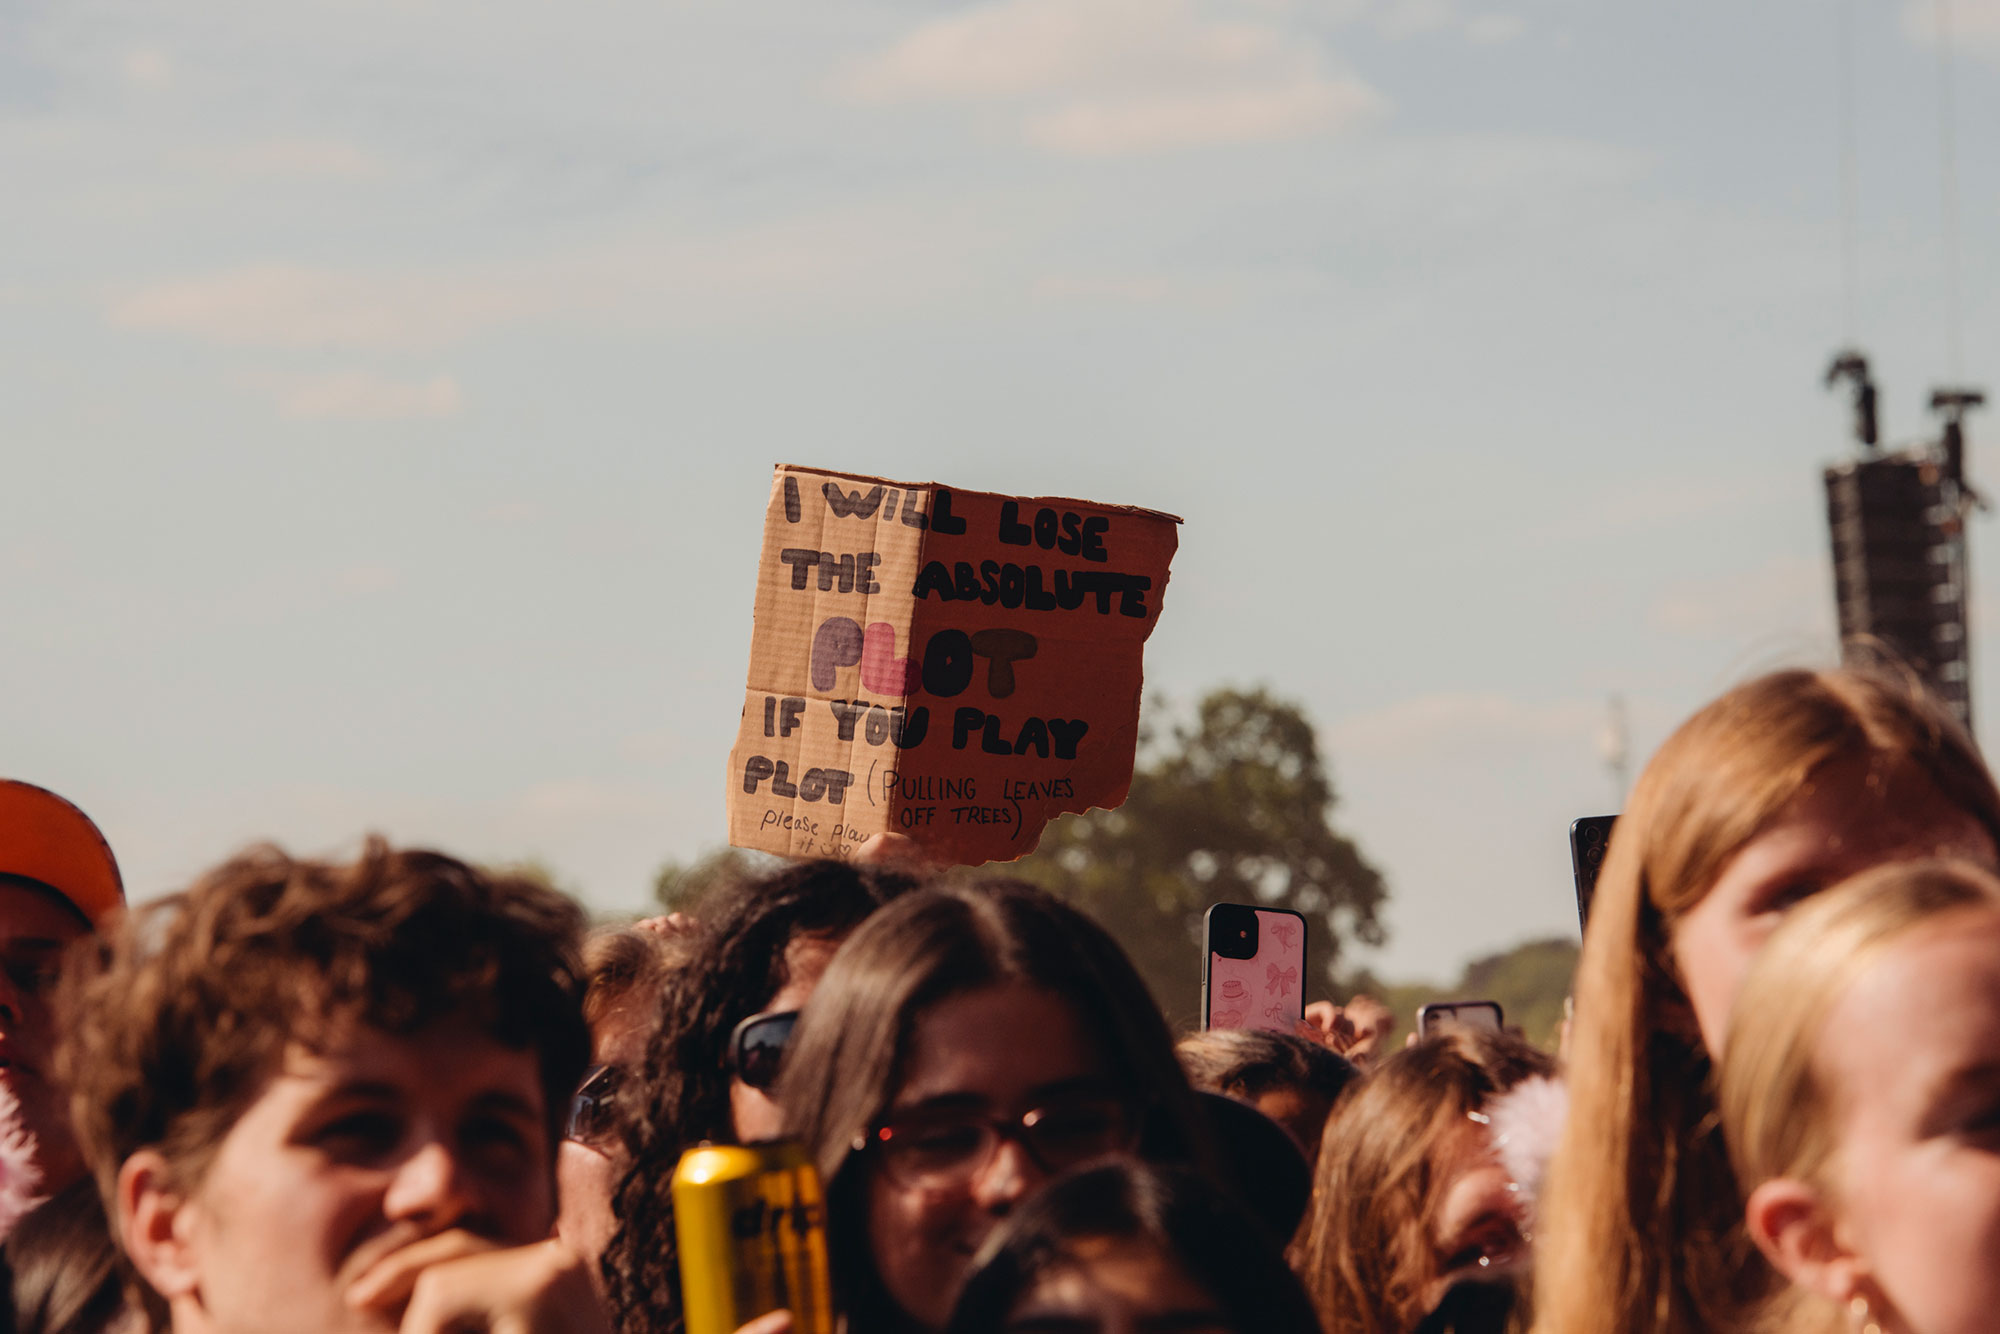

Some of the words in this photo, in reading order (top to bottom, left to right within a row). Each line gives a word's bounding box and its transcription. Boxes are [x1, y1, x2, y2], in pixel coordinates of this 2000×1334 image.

[783, 476, 802, 523] I
[821, 482, 967, 536] WILL
[998, 501, 1109, 563] LOSE
[780, 548, 882, 595] THE
[911, 559, 1152, 618] ABSOLUTE
[810, 616, 1038, 699] PLOT
[763, 696, 806, 738] IF
[829, 699, 929, 749] YOU
[951, 707, 1089, 760] PLAY
[743, 755, 855, 805] PLOT
[867, 759, 977, 807] (PULLING
[1003, 778, 1075, 801] LEAVES
[760, 809, 819, 836] please
[900, 806, 937, 829] OFF
[950, 796, 1023, 841] TREES)
